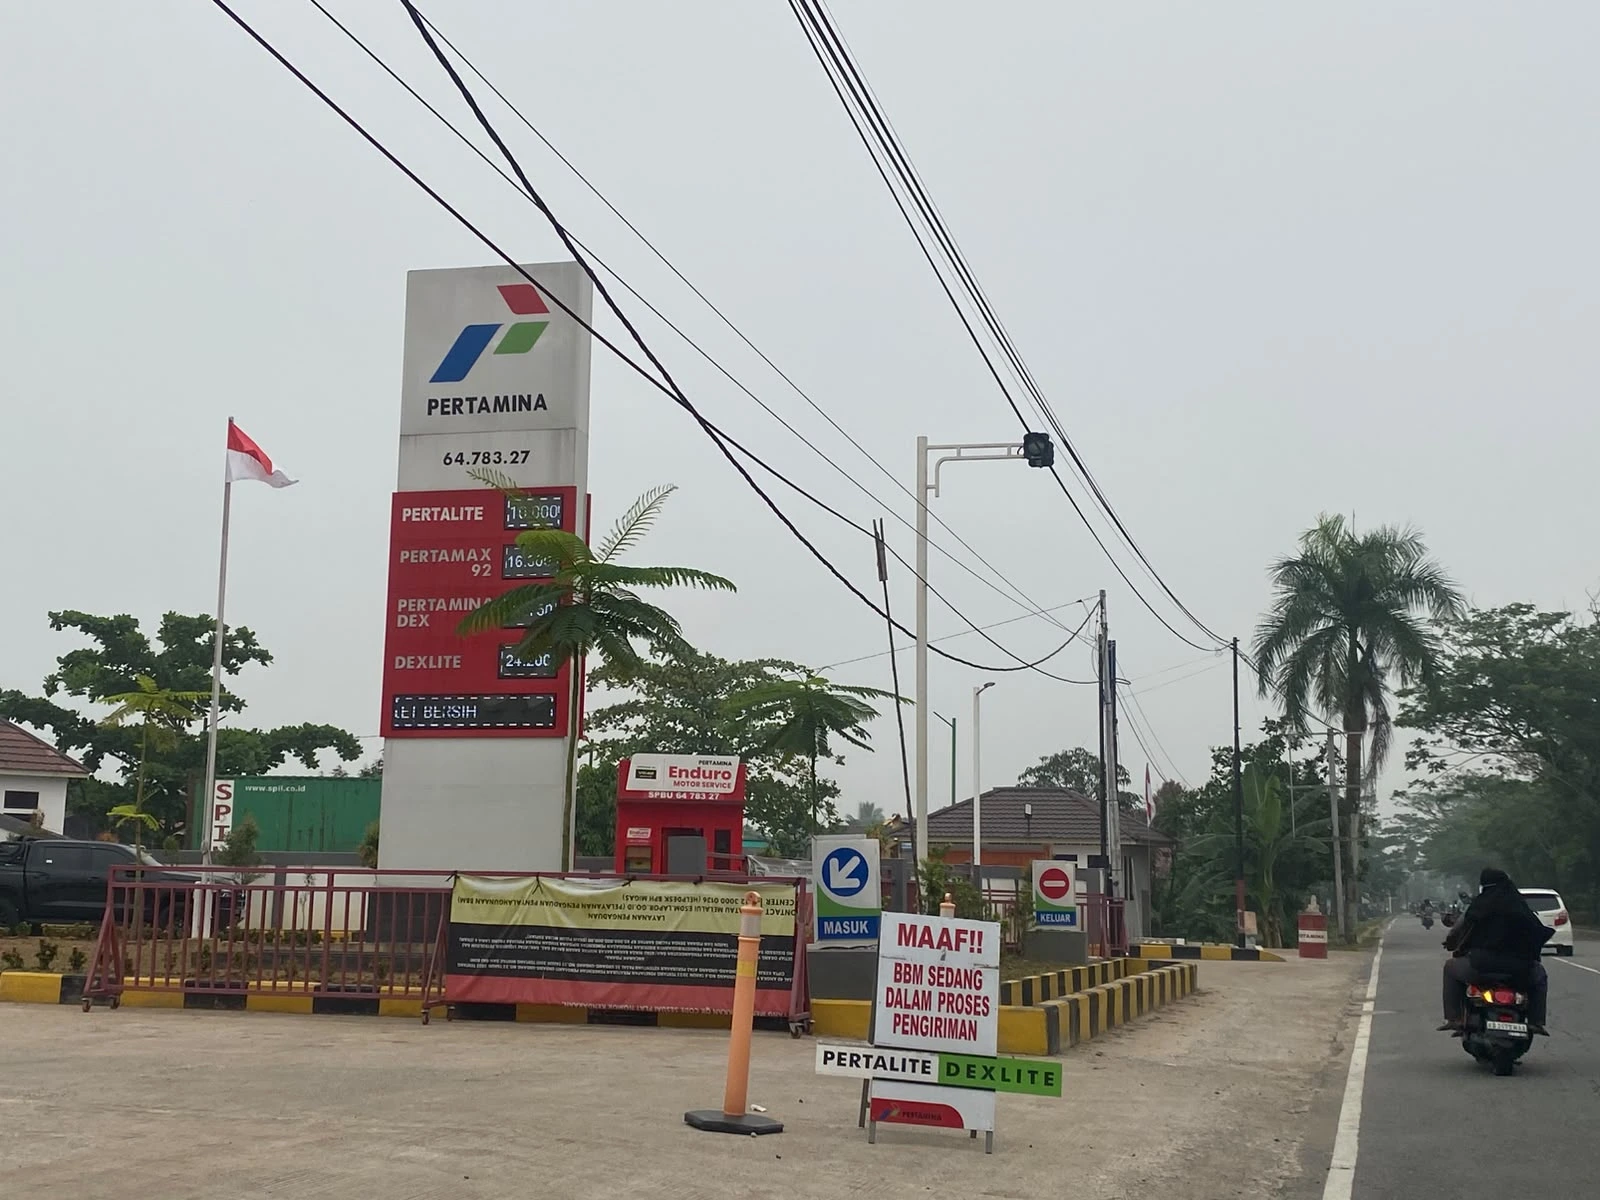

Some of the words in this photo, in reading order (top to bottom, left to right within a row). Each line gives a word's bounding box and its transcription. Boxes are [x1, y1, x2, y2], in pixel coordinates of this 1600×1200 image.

[427, 393, 548, 416] PERTAMINA
[443, 450, 531, 466] 64.783.27
[402, 506, 484, 522] PERTALITE
[399, 548, 492, 563] PERTAMAX
[471, 563, 492, 577] 92
[397, 614, 430, 628] DEX
[394, 655, 462, 669] DEXLITE
[668, 766, 732, 780] Enduro
[673, 780, 701, 788] MOTOR
[701, 781, 732, 789] SERVICE
[648, 791, 673, 799] SPBU
[675, 792, 687, 800] 64
[690, 792, 706, 800] 783
[213, 783, 232, 849] SPI
[622, 894, 648, 902] MIGAS)
[766, 898, 795, 907] CENTER
[694, 905, 724, 913] MELALUI
[587, 913, 631, 921] PENGADUAN
[632, 914, 666, 922] LAYANAN
[1040, 913, 1072, 923] KELUAR
[824, 920, 870, 935] MASUK
[897, 923, 984, 954] MAAF!!
[893, 963, 923, 987] BBM
[928, 965, 983, 991] SEDANG
[885, 987, 933, 1012] DALAM
[937, 992, 990, 1017] PROSES
[893, 1013, 978, 1042] PENGIRIMAN
[823, 1050, 932, 1075] PERTALITE
[946, 1062, 1055, 1087] DEXLITE
